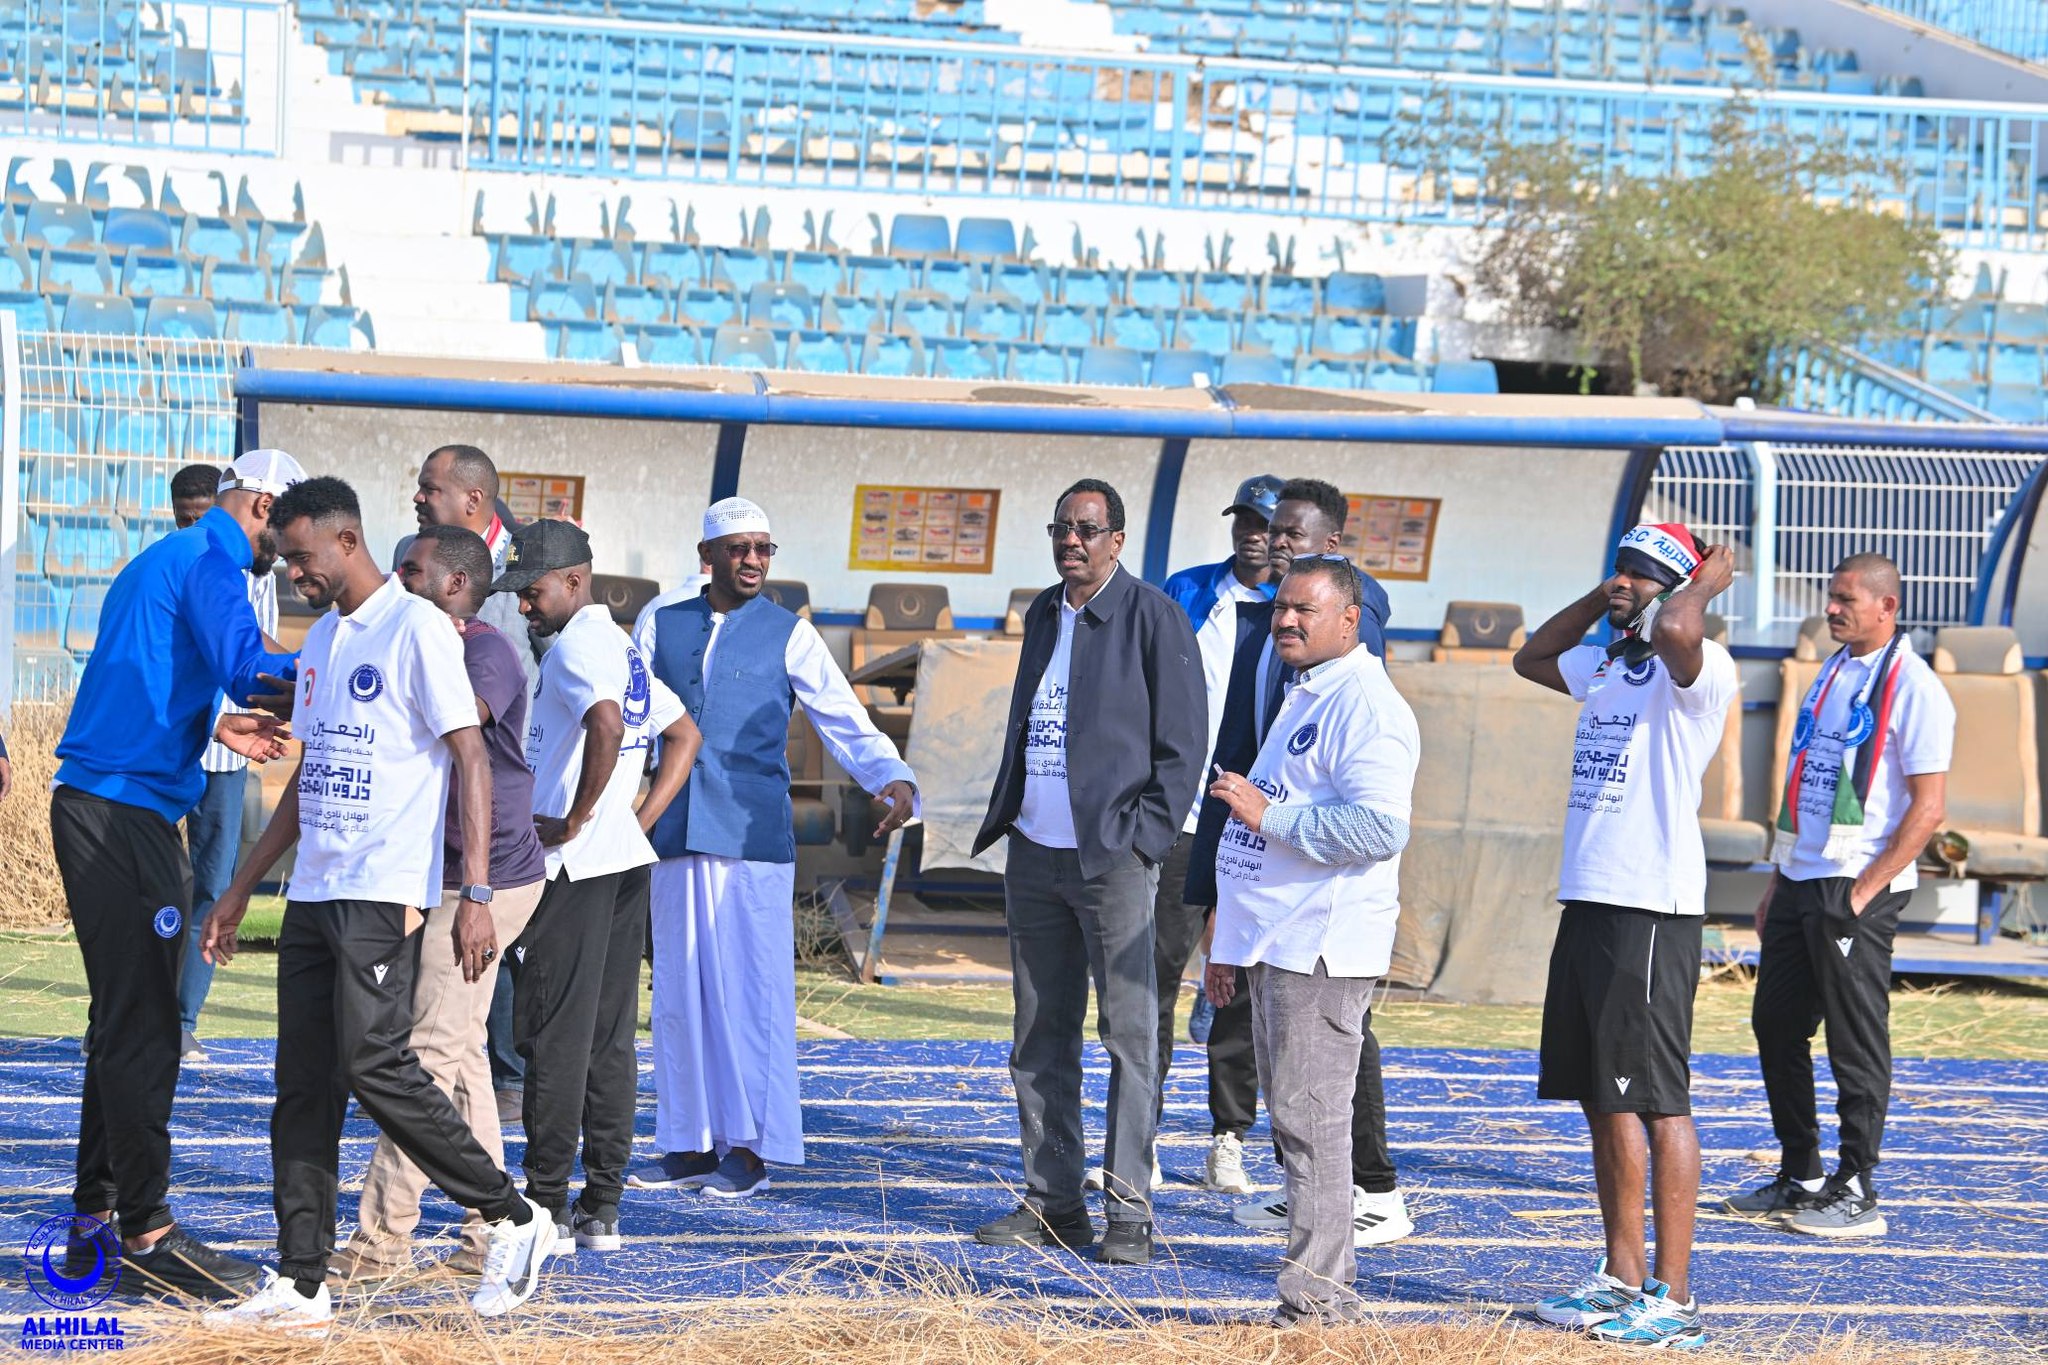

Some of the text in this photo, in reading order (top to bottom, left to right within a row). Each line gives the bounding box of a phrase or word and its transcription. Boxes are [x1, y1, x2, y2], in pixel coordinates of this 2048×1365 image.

[1589, 711, 1637, 731] اجعين
[311, 717, 375, 744] راجعين
[1598, 792, 1623, 804] الهلال
[342, 812, 369, 823] الهلال
[1237, 859, 1262, 871] الهلال
